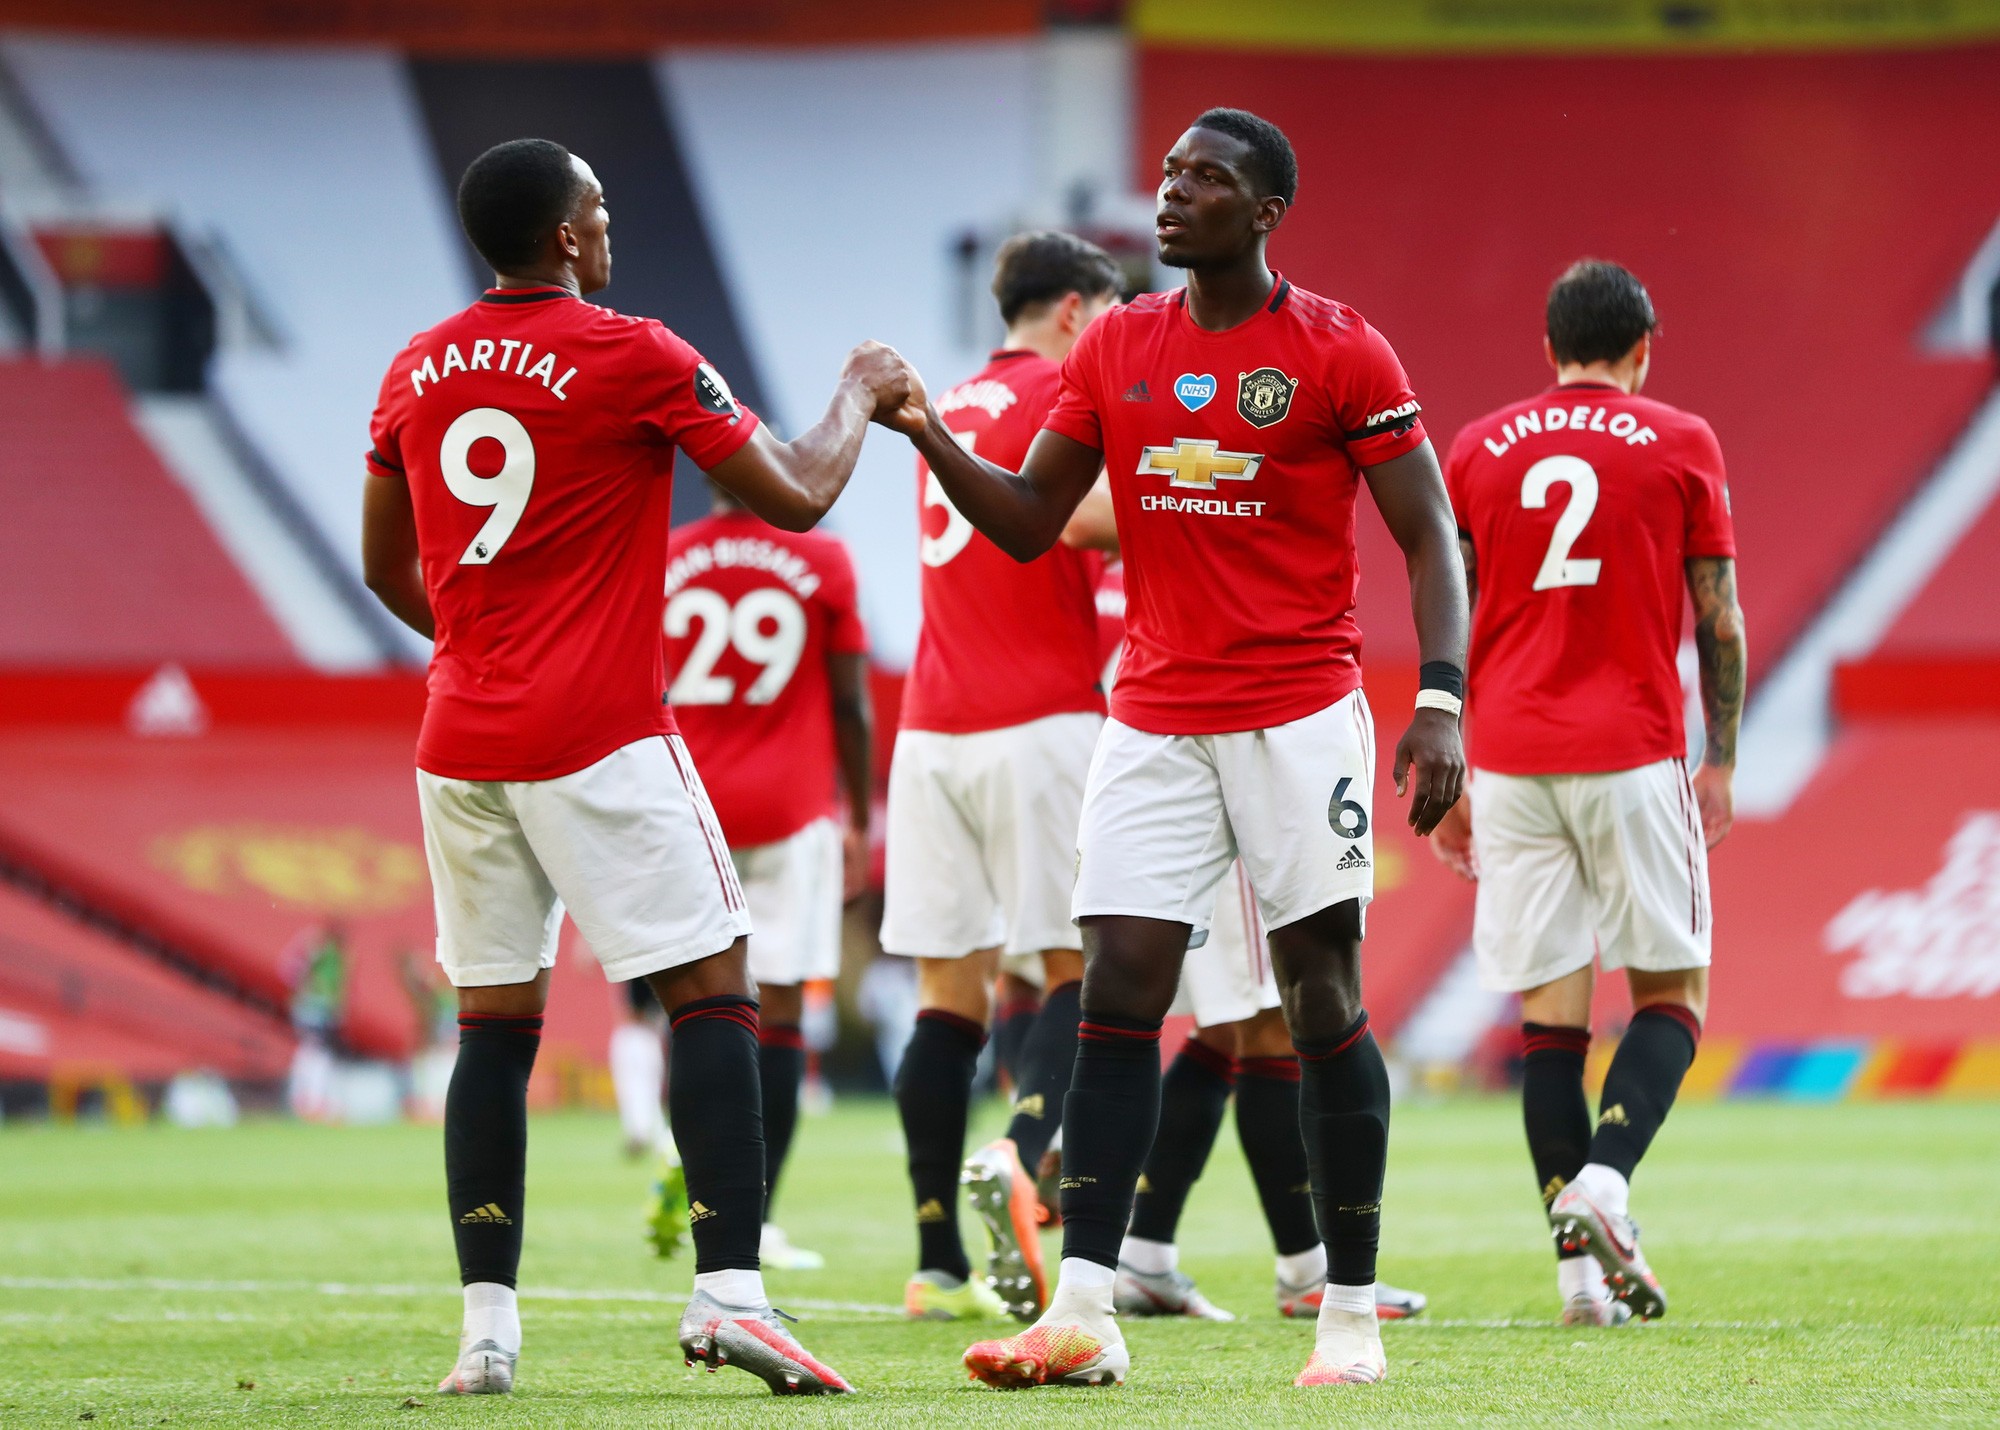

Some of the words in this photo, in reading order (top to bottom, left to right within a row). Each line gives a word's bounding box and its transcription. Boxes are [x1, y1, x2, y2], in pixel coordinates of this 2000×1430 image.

[410, 338, 578, 402] MARTIAL
[1248, 377, 1284, 394] MANCHESTER
[1182, 385, 1209, 397] NHS
[1249, 406, 1275, 416] UNITED
[1484, 405, 1658, 457] LINDELOF
[440, 407, 537, 565] 9
[1140, 495, 1267, 517] CHEVROLET
[1521, 454, 1603, 592] 2
[662, 586, 808, 706] 29
[1327, 776, 1368, 840] 6
[1336, 859, 1371, 871] adidas
[459, 1214, 513, 1225] adidas
